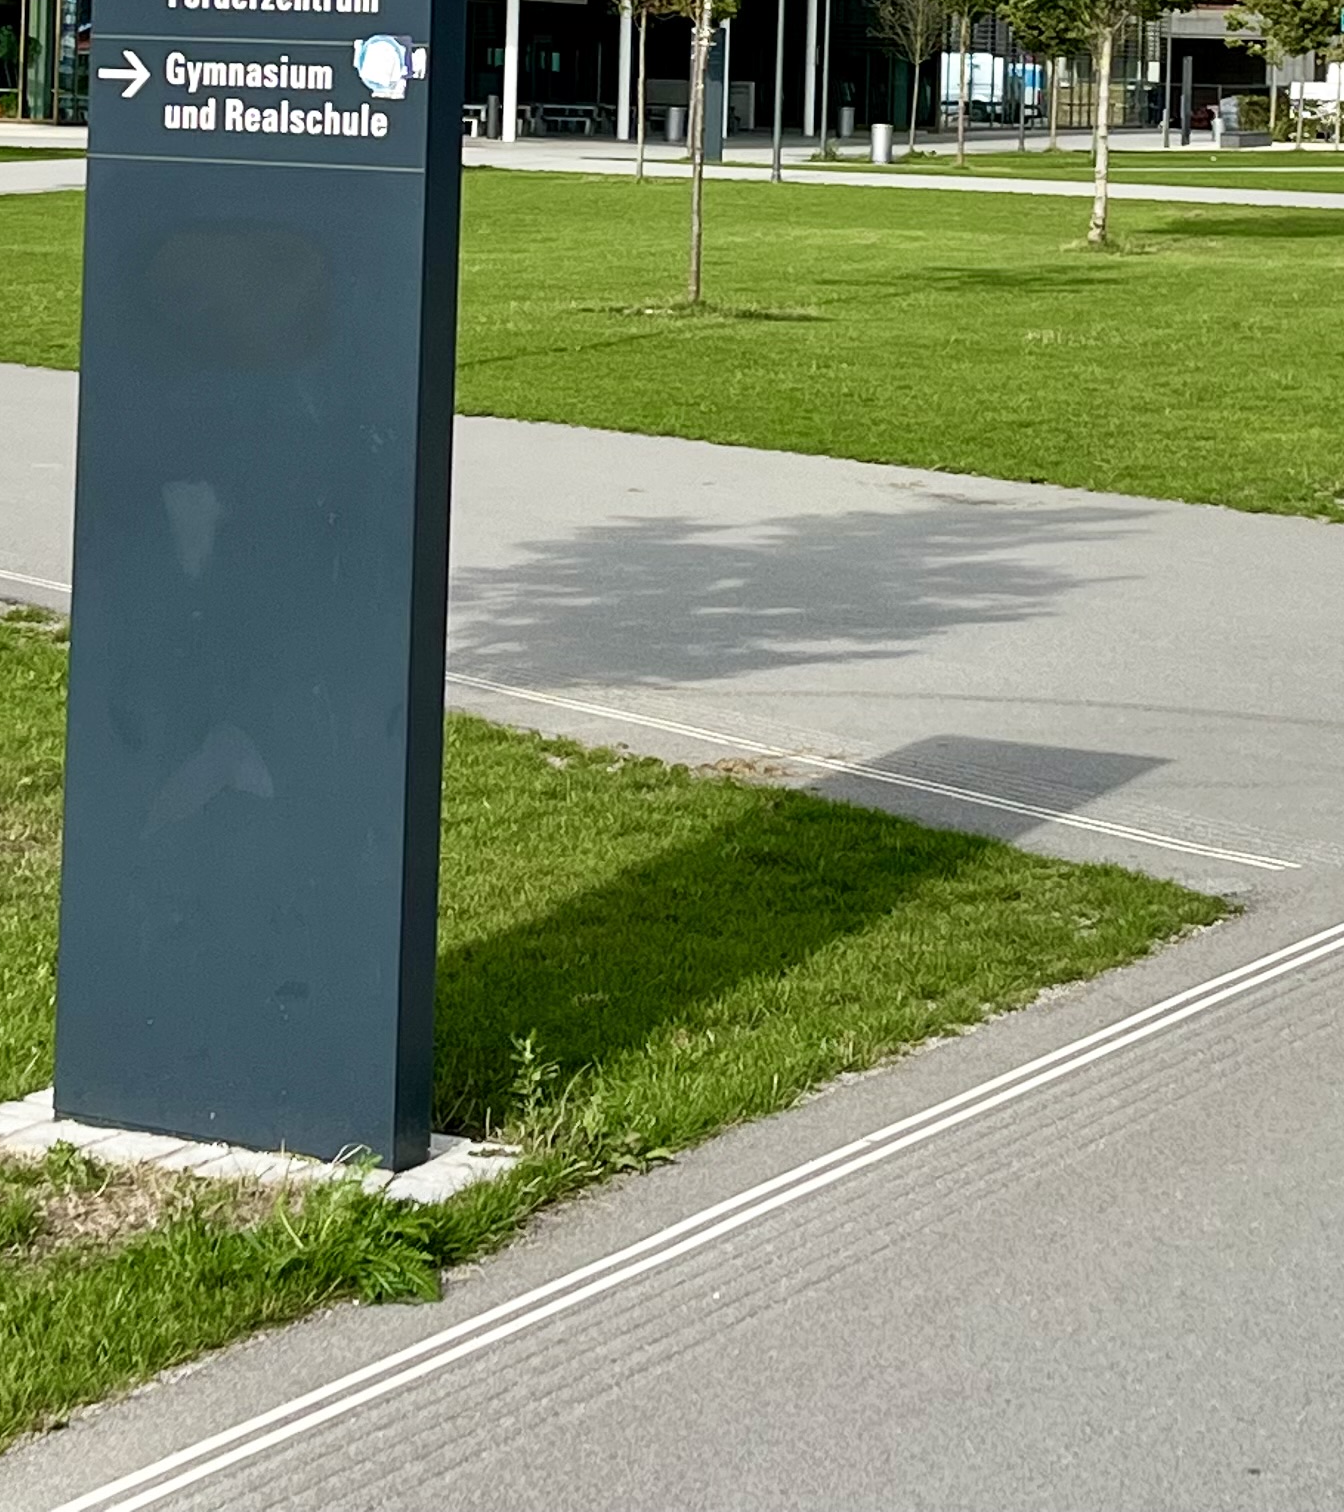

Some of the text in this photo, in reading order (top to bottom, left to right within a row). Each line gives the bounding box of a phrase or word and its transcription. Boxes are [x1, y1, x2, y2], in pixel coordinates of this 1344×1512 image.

[165, 51, 333, 93] Gymnasium
[164, 97, 389, 137] und Realschule
